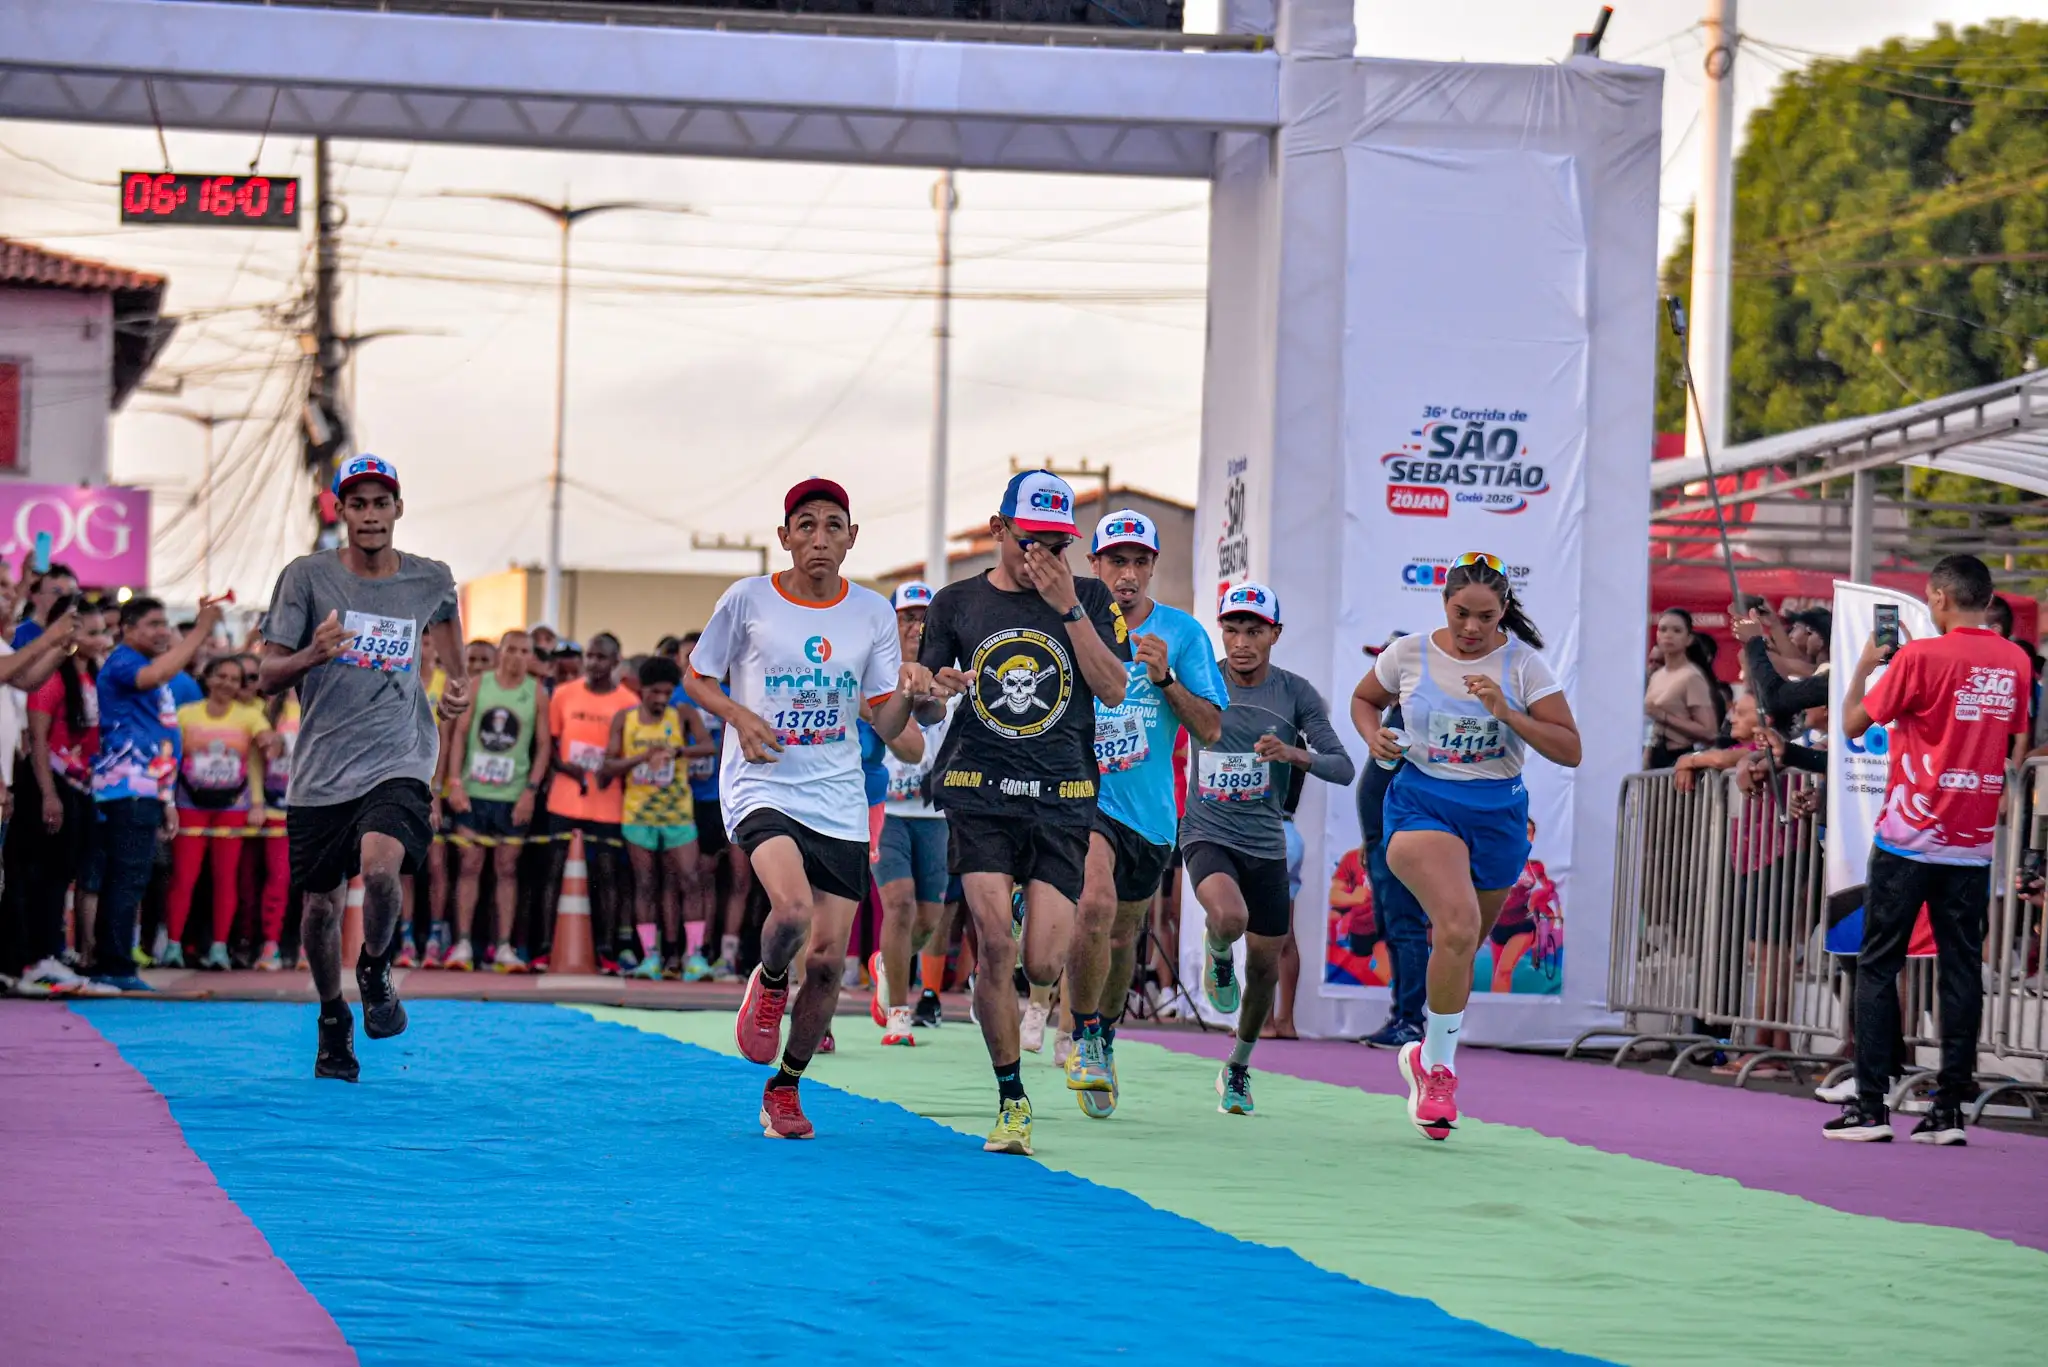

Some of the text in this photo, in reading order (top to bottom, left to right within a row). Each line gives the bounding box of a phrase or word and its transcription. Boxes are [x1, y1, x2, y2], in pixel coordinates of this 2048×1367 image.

[124, 174, 296, 217] 06:16:01
[1451, 407, 1505, 422] Corrida
[1509, 410, 1528, 422] de
[1428, 421, 1518, 462] SÃO
[1388, 460, 1544, 488] SEBASTIÃO
[1031, 492, 1069, 512] CODÓ
[1455, 492, 1513, 504] Codó 2026
[0, 498, 130, 560] OG
[1105, 520, 1145, 536] CODÓ
[1402, 565, 1447, 585] COD
[1507, 566, 1530, 578] ESP
[353, 635, 409, 657] 13359
[764, 666, 811, 674] ESPAÇO
[1972, 674, 2013, 695] SÃO
[774, 709, 838, 728] 13785
[1145, 719, 1158, 728] DO
[1094, 734, 1139, 759] 3827
[1440, 733, 1499, 749] 14114
[943, 770, 1095, 798] 200KM 400KM 600KM
[1207, 772, 1263, 788] 13893
[1845, 771, 1887, 781] Secretari
[1847, 784, 1886, 795] de Espo
